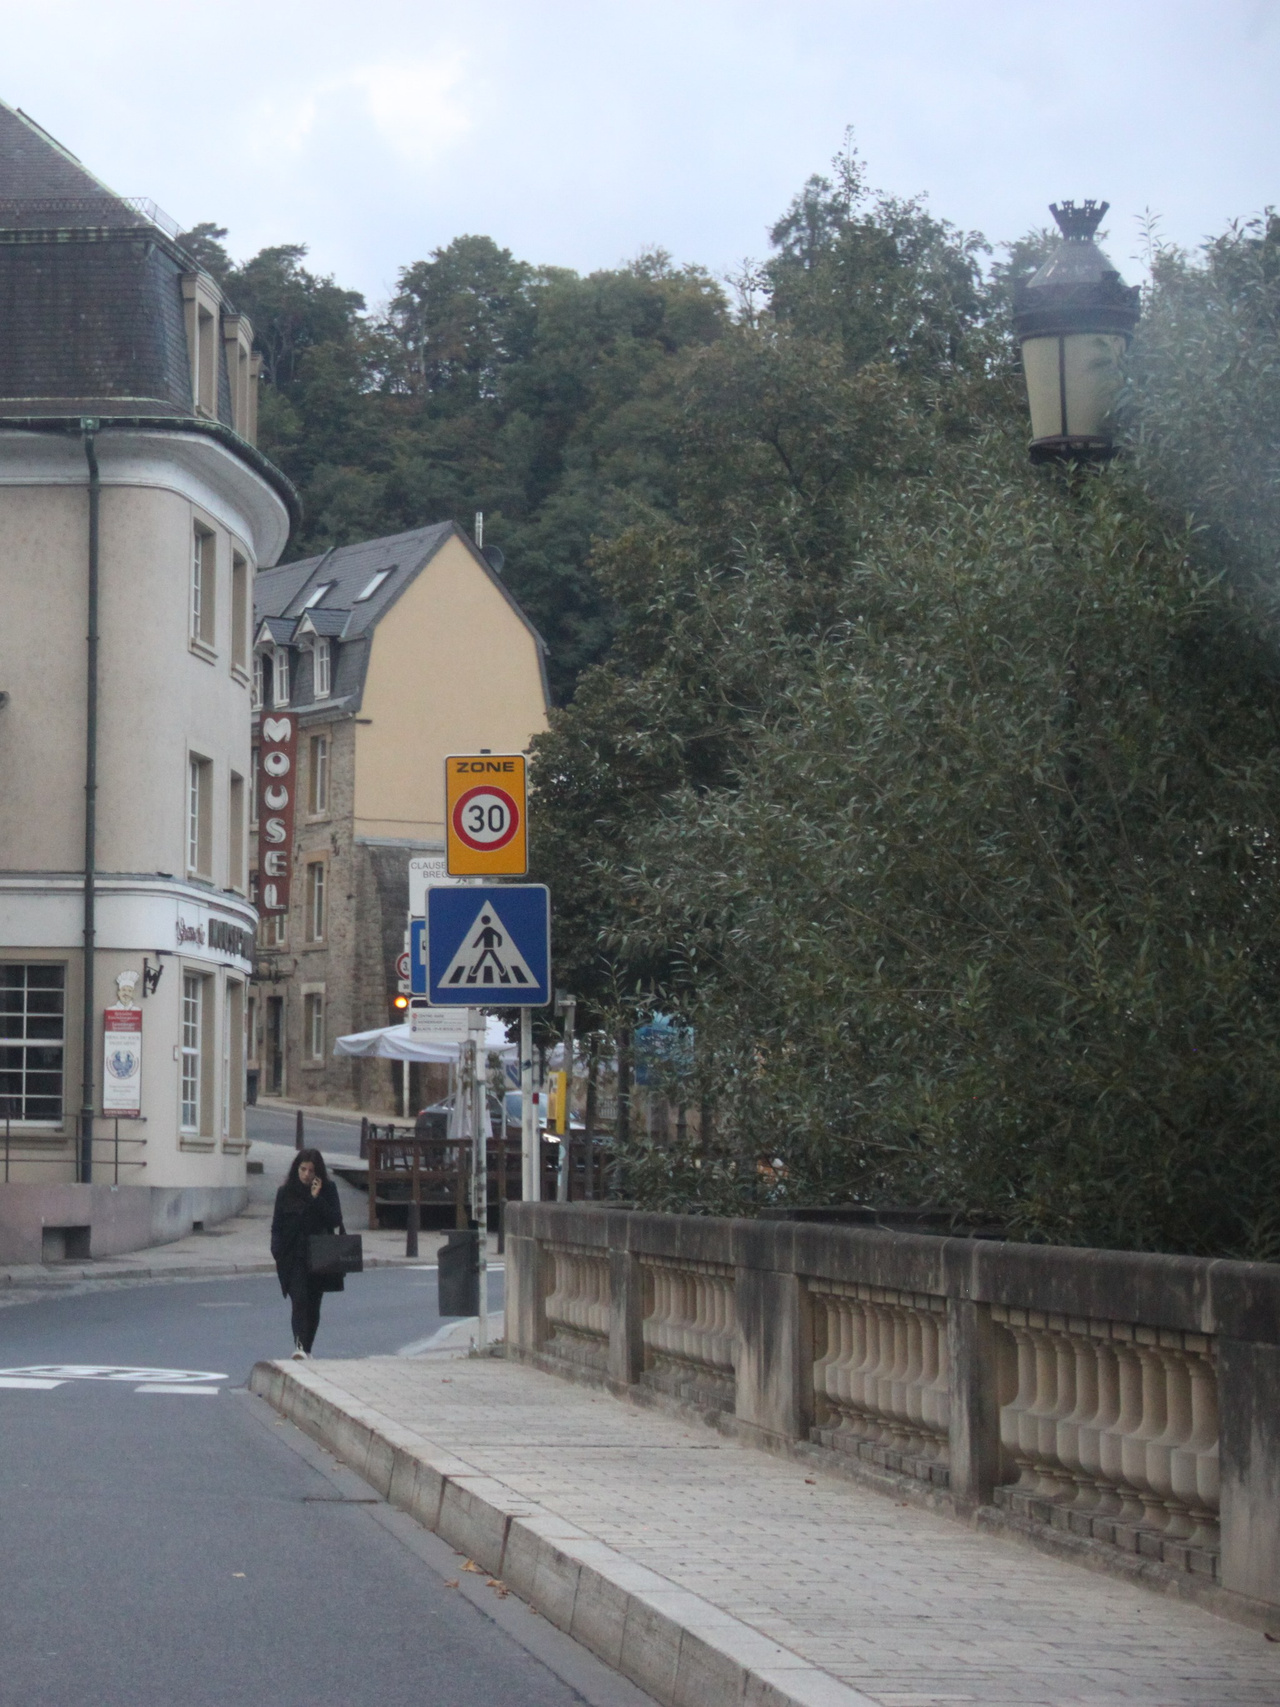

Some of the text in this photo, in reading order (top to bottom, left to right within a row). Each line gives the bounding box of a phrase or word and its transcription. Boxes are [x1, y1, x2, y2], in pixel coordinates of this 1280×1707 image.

[457, 762, 514, 773] ZONE
[263, 717, 292, 910] MOUSEL
[468, 805, 504, 832] 30
[411, 861, 446, 870] CLAUSE
